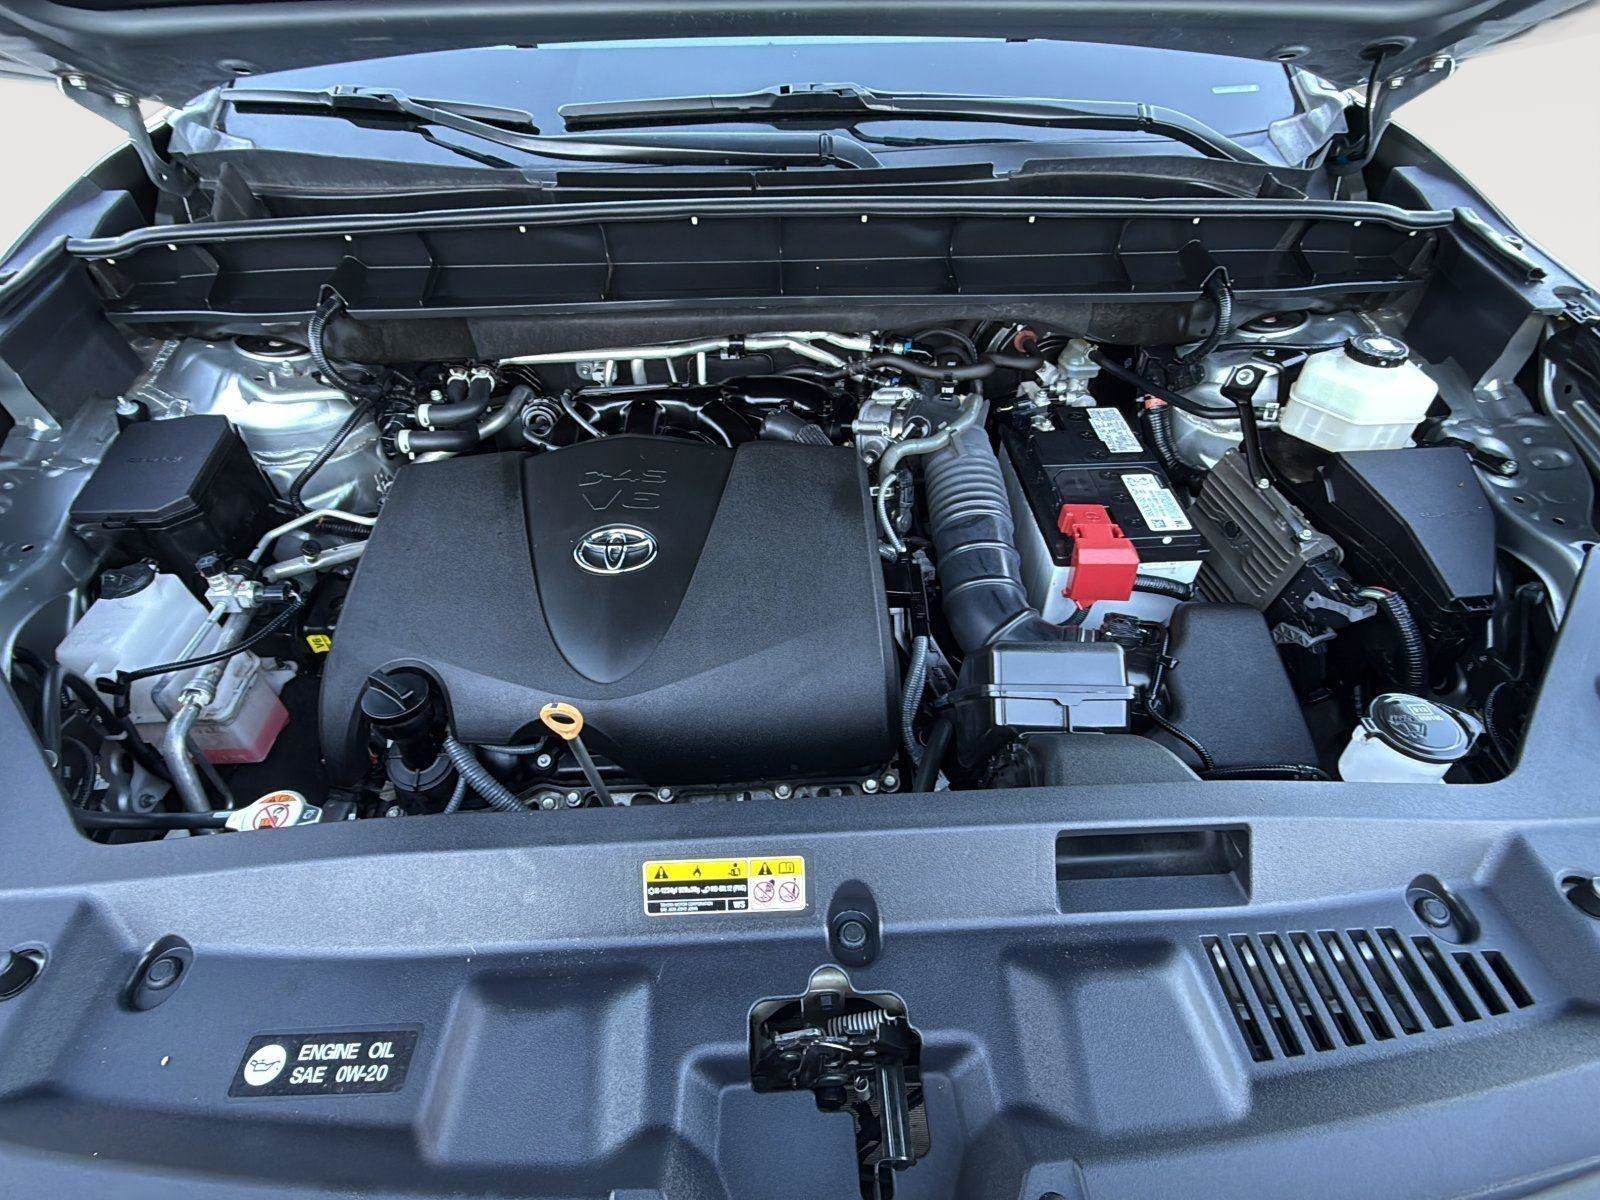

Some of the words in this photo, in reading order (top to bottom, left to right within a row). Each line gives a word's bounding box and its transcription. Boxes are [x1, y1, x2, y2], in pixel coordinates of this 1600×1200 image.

[297, 1042, 362, 1061] ENGINE
[368, 1041, 395, 1059] OIL
[289, 1066, 328, 1085] SAE
[335, 1064, 389, 1083] 0W-20
